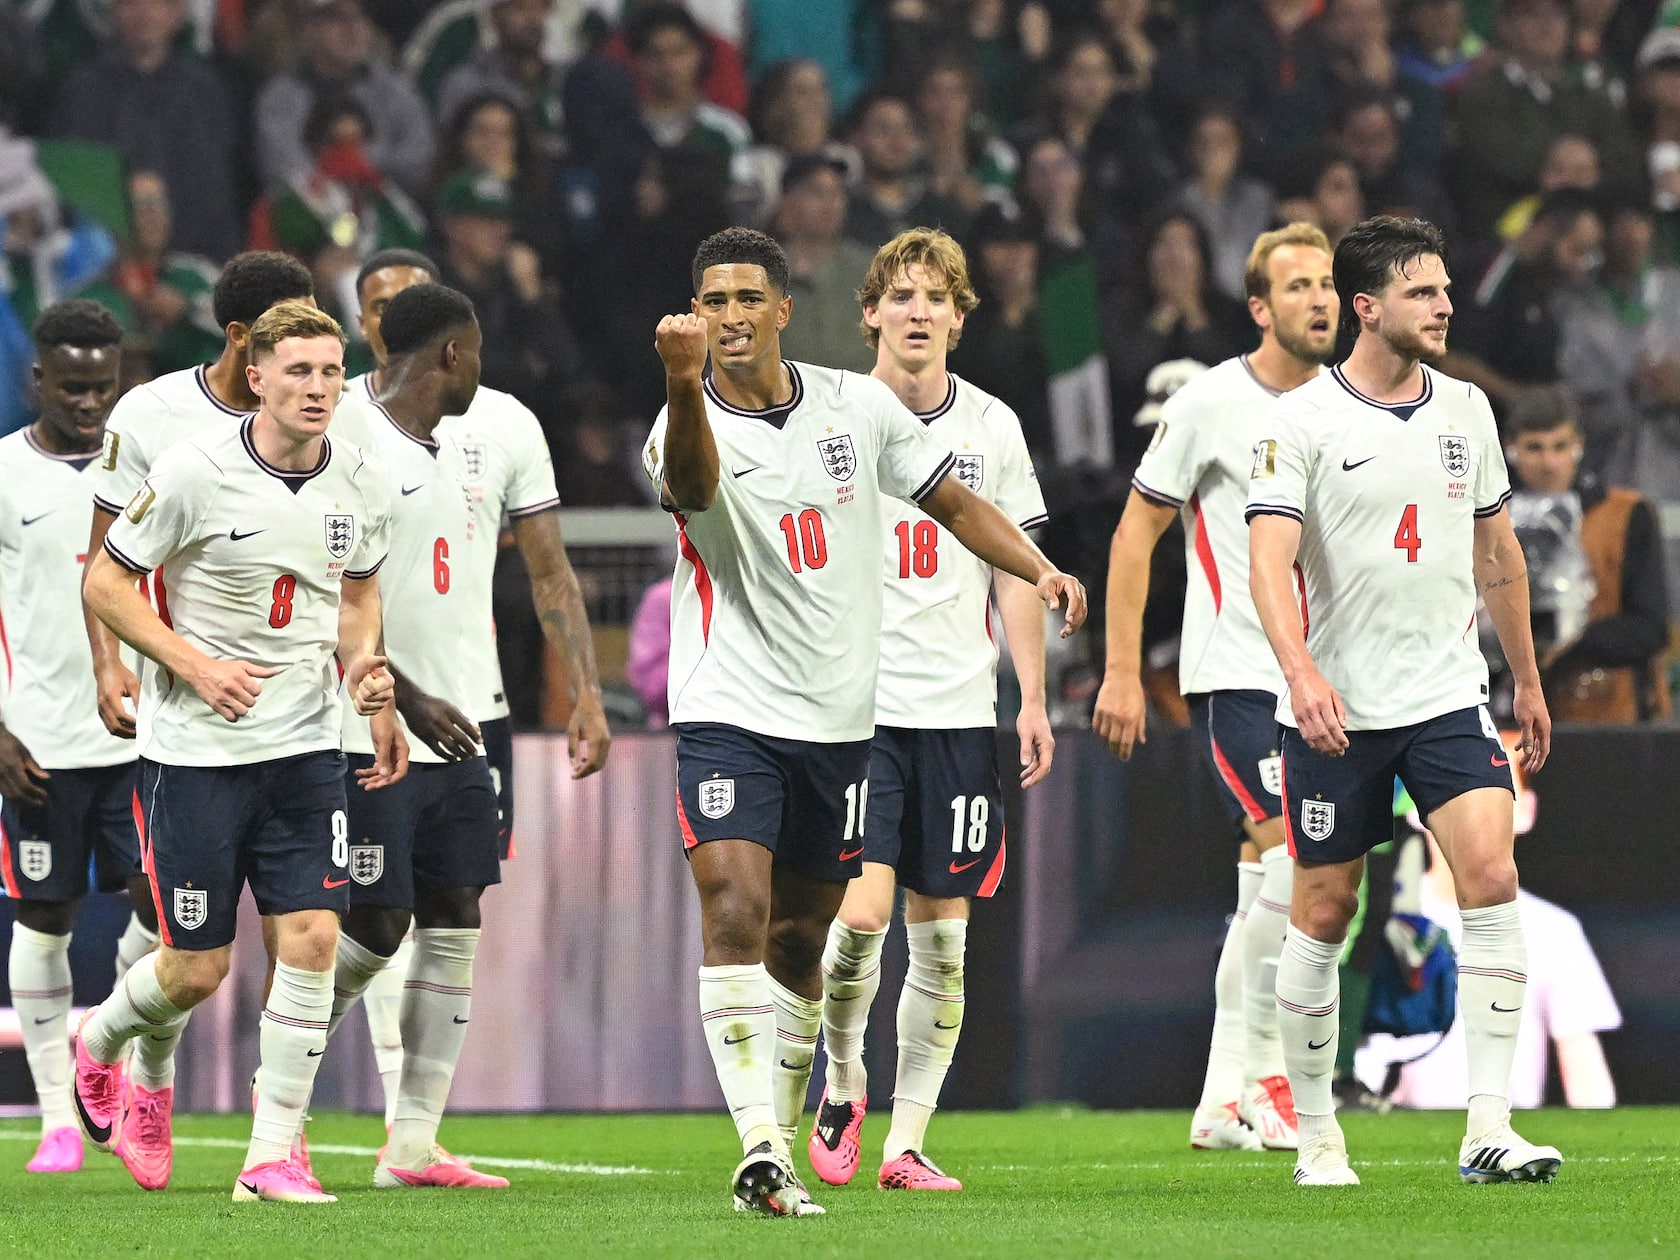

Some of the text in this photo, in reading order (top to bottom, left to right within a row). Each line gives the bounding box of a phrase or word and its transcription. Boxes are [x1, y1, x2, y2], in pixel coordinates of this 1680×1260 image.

[836, 484, 855, 494] MEXICO
[780, 509, 828, 573] 10
[895, 520, 938, 579] 18
[1394, 504, 1422, 562] 4
[433, 537, 450, 595] 6
[269, 575, 295, 628] 8
[331, 809, 349, 868] 8
[950, 795, 989, 853] 18
